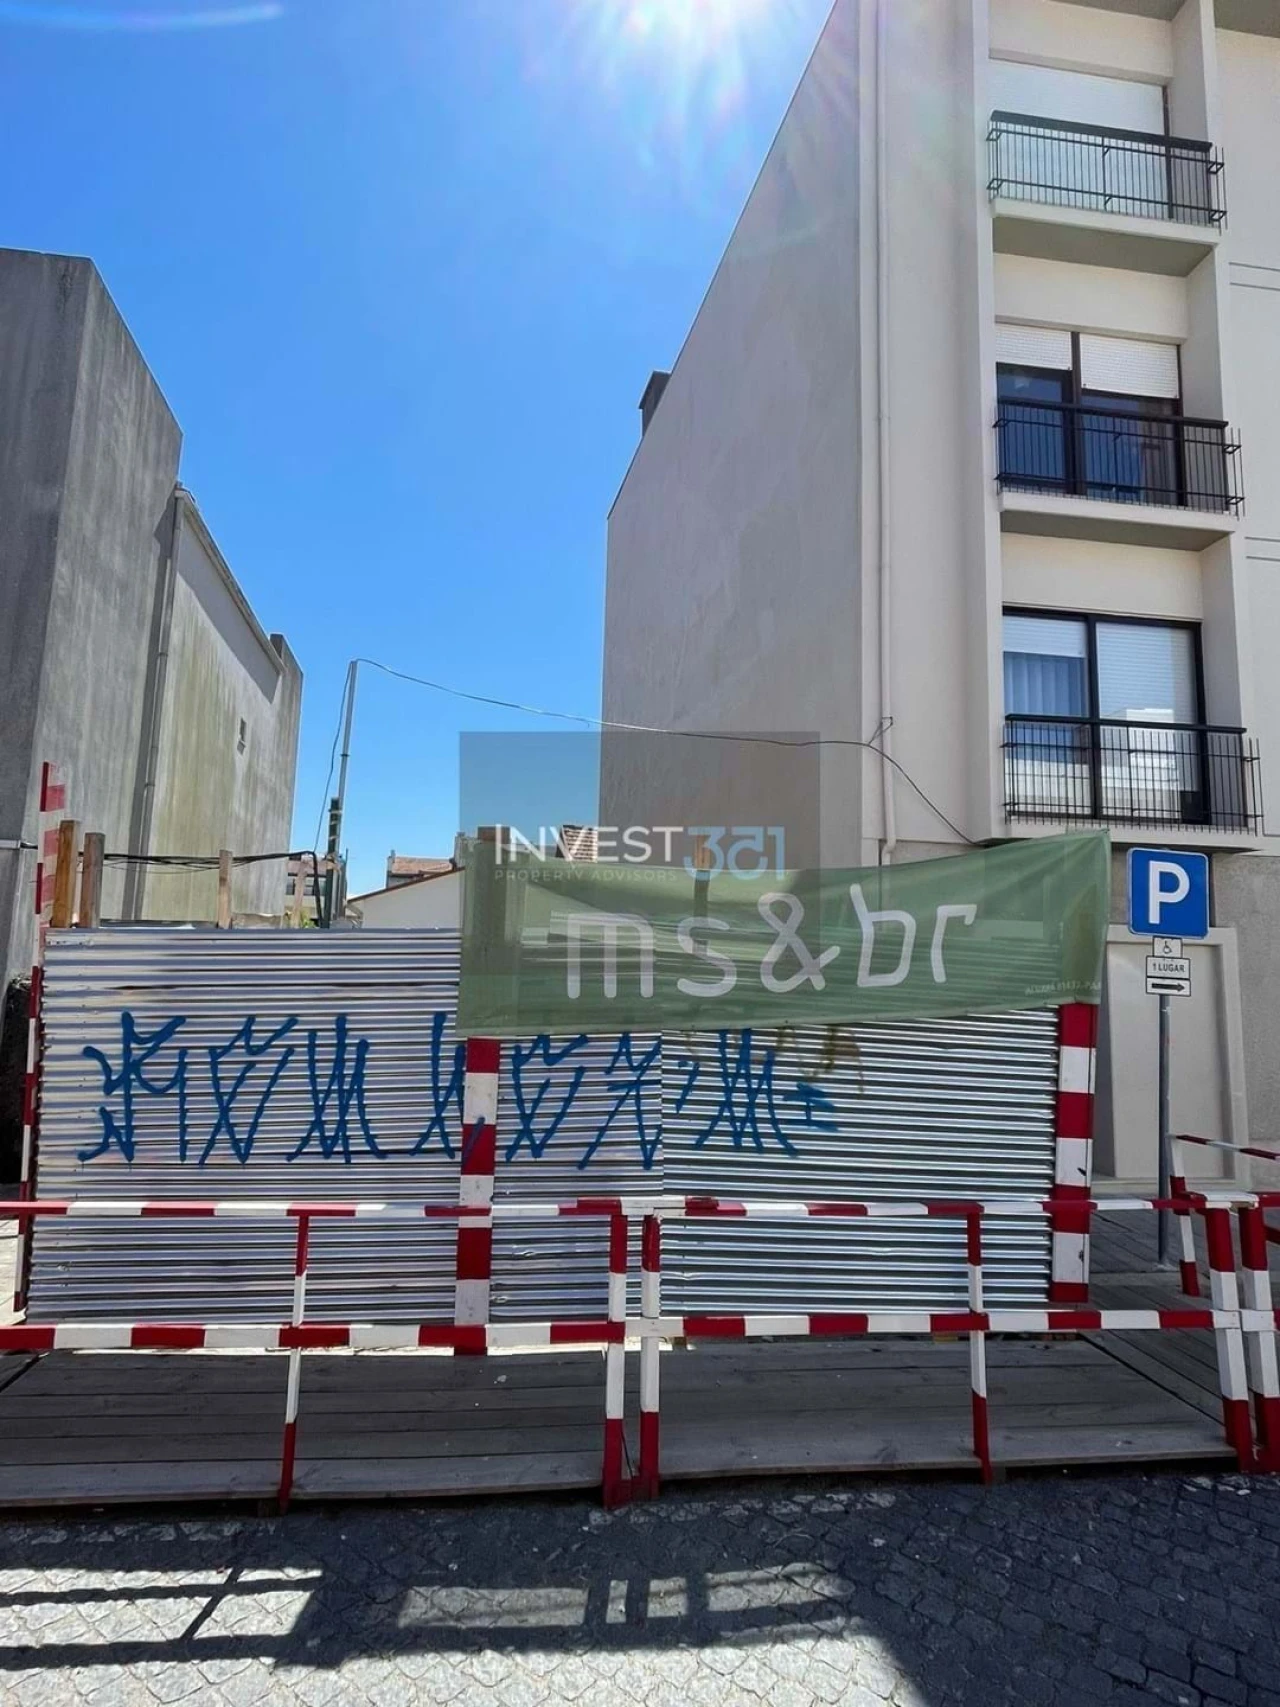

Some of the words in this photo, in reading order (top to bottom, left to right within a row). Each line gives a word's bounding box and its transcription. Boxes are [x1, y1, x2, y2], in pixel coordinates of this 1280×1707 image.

[1148, 860, 1190, 924] P
[1152, 962, 1157, 972] 1
[1158, 963, 1185, 973] LUGAR
